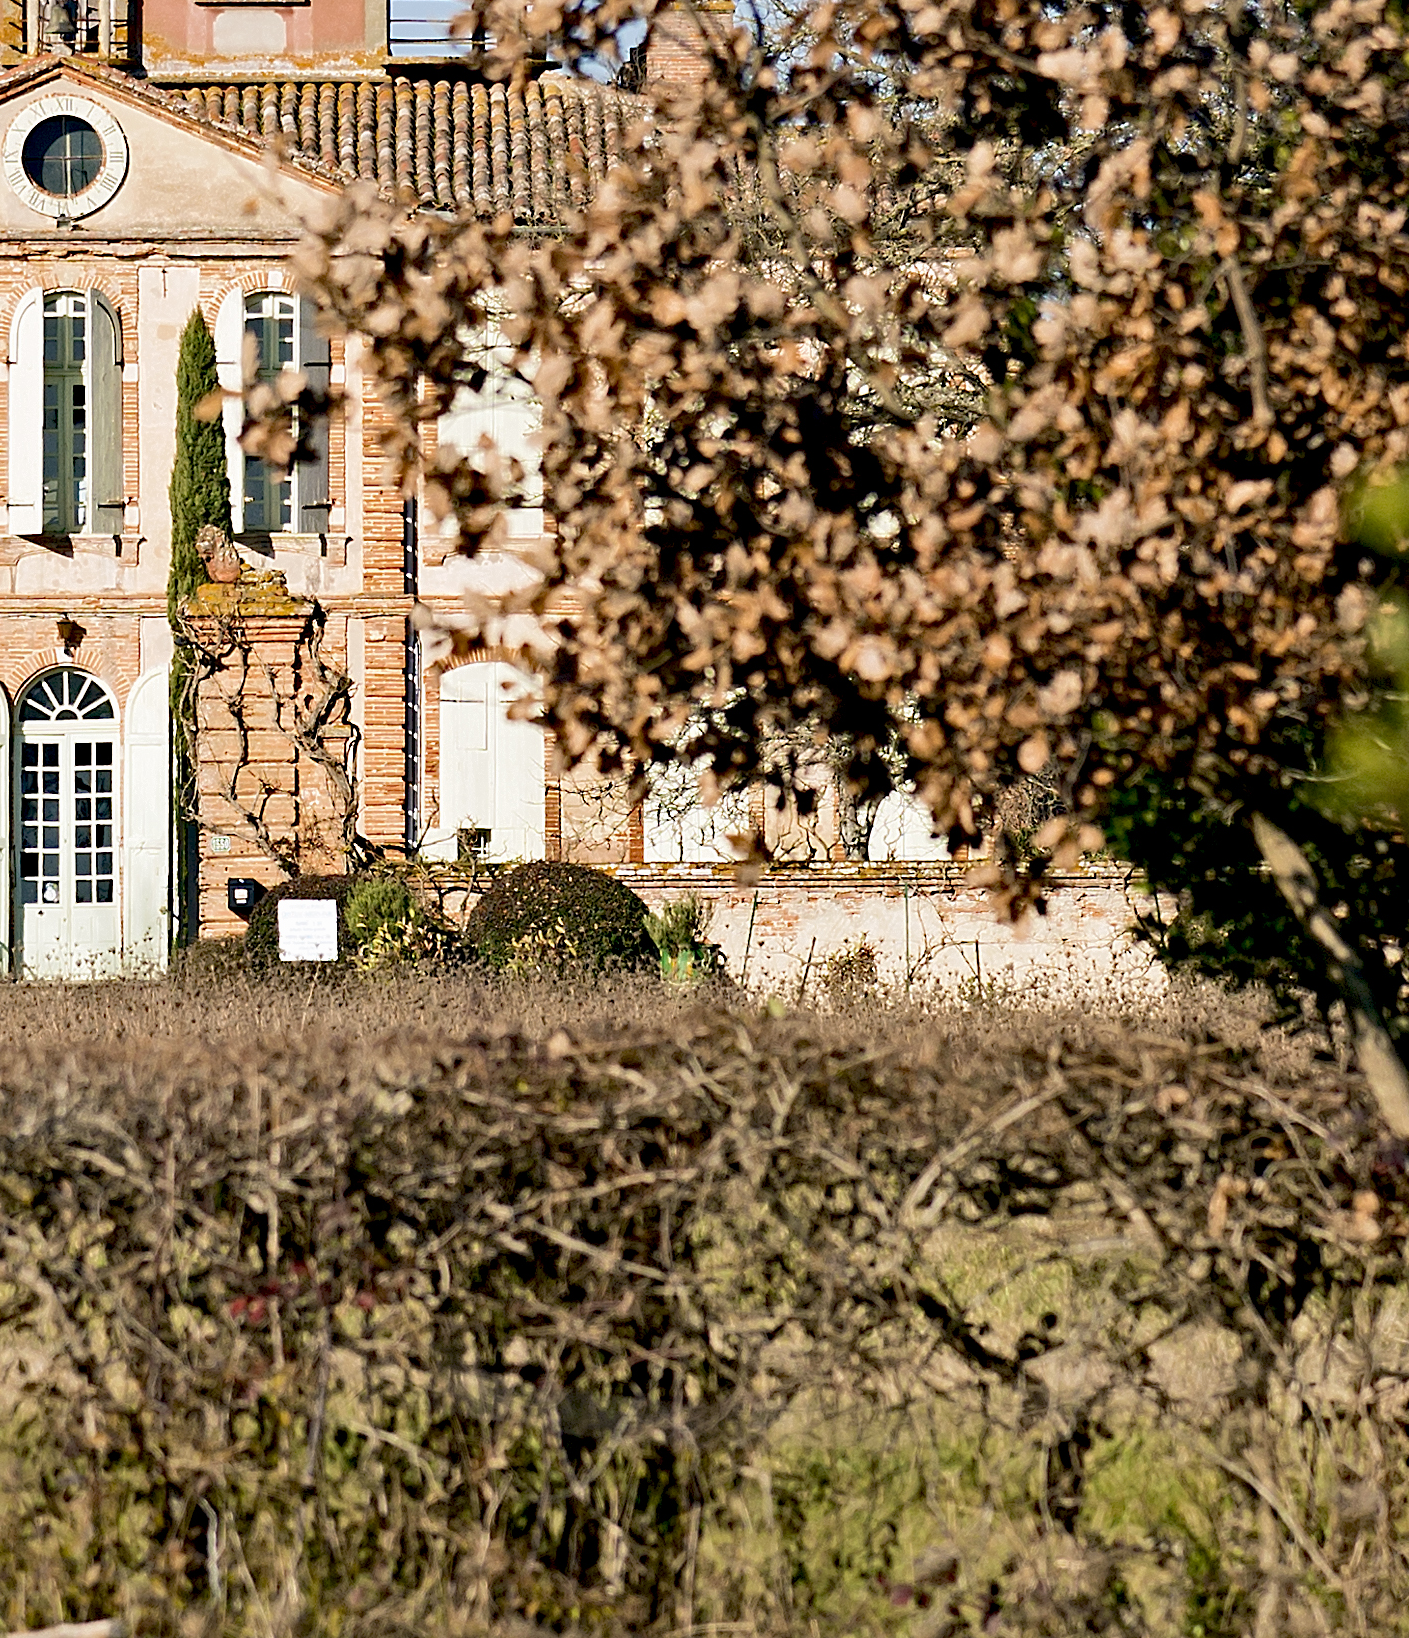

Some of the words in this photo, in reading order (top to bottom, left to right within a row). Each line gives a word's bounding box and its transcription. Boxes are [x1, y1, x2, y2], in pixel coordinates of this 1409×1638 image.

[30, 101, 47, 118] XI
[56, 97, 73, 111] XII
[87, 105, 95, 118] I
[11, 123, 27, 138] X
[102, 124, 117, 136] II
[109, 151, 125, 163] III
[8, 170, 27, 196] VIII
[99, 172, 119, 193] IIII
[28, 191, 46, 211] VII
[86, 196, 98, 210] V
